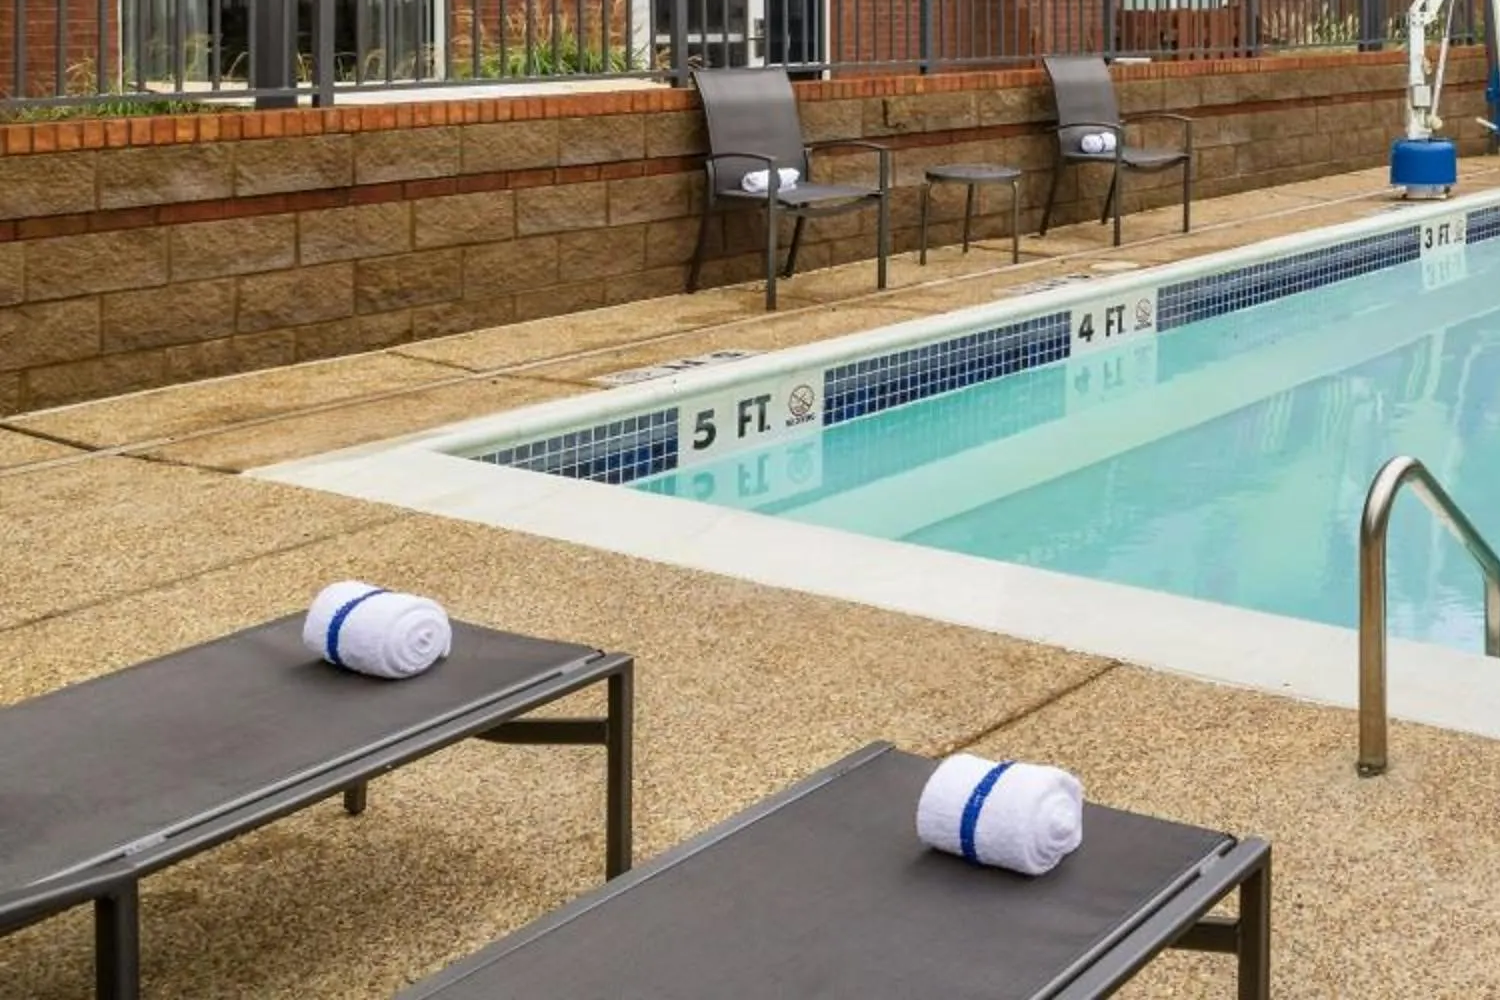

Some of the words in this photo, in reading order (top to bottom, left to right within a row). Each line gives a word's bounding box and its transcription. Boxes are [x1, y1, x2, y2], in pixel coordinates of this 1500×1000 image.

[1424, 227, 1433, 249] 3
[1078, 312, 1095, 342] 4
[693, 408, 717, 450] 5
[737, 393, 771, 438] FT.
